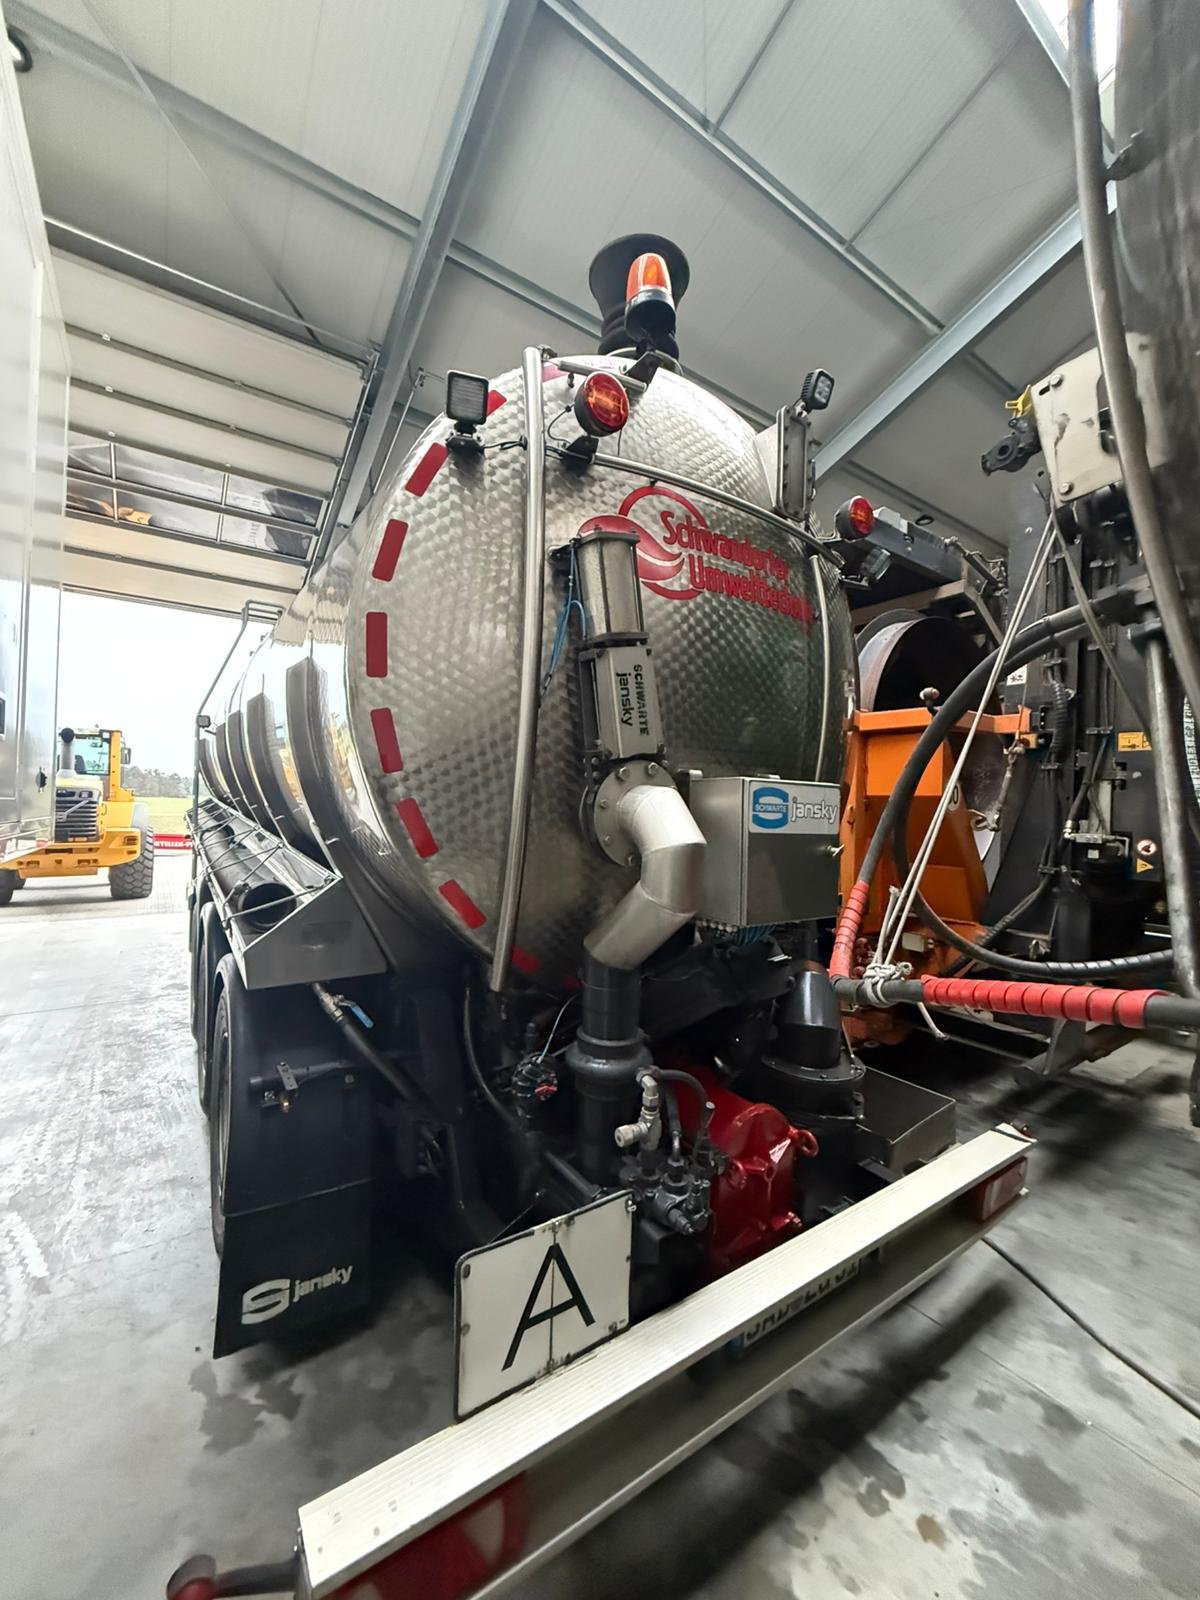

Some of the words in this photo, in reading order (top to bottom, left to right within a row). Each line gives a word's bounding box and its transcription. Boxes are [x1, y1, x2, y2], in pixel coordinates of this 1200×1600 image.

[616, 672, 635, 726] jansky
[633, 664, 650, 736] SCHWARTE
[791, 796, 838, 824] jansky
[293, 1265, 354, 1303] jansky
[501, 1243, 596, 1372] A
